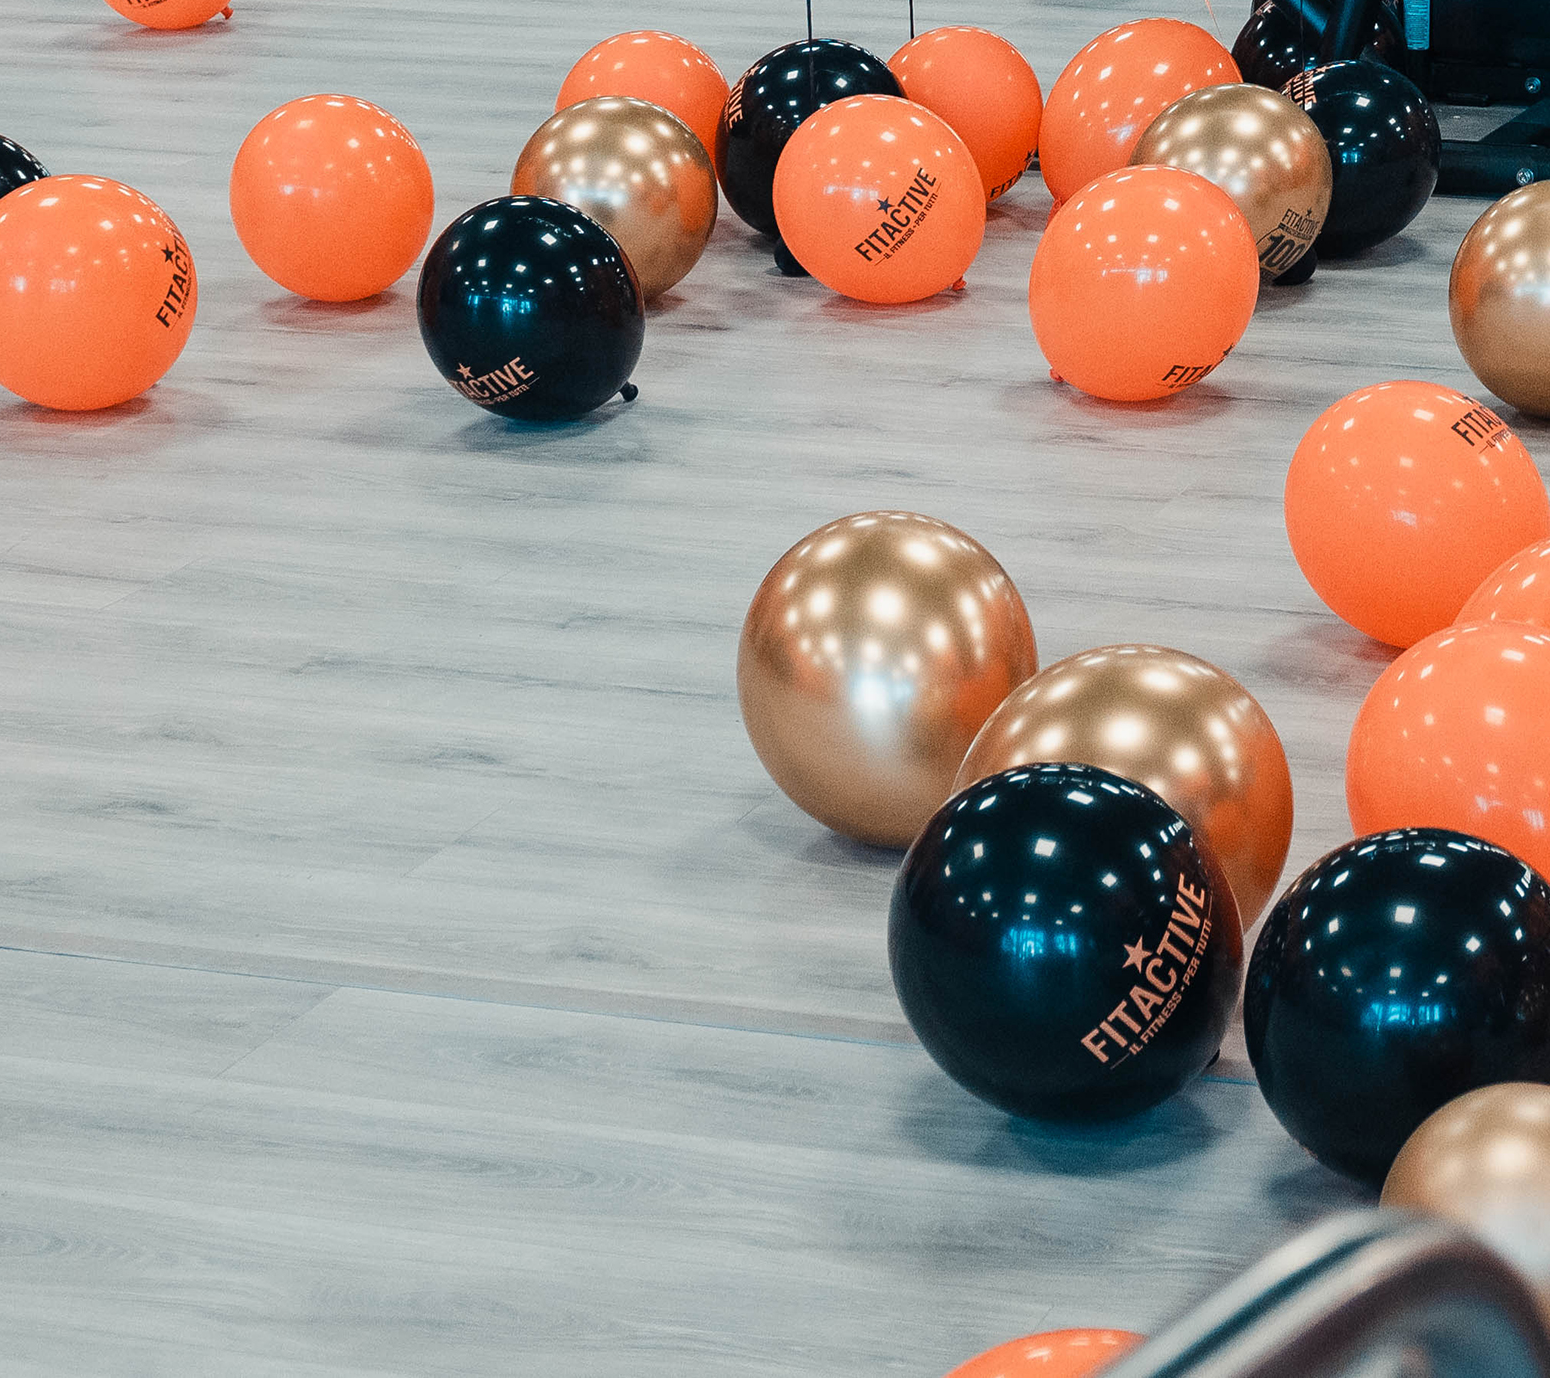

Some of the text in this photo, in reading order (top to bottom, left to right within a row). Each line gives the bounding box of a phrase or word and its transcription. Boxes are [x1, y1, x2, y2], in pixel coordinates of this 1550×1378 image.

[854, 167, 937, 262] FITACTIVE
[883, 192, 939, 260] IL FITNESS PER TUTTI
[1082, 873, 1208, 1064] FITACTIVE
[1129, 918, 1212, 1056] IL FITNESS PER TUTTI
